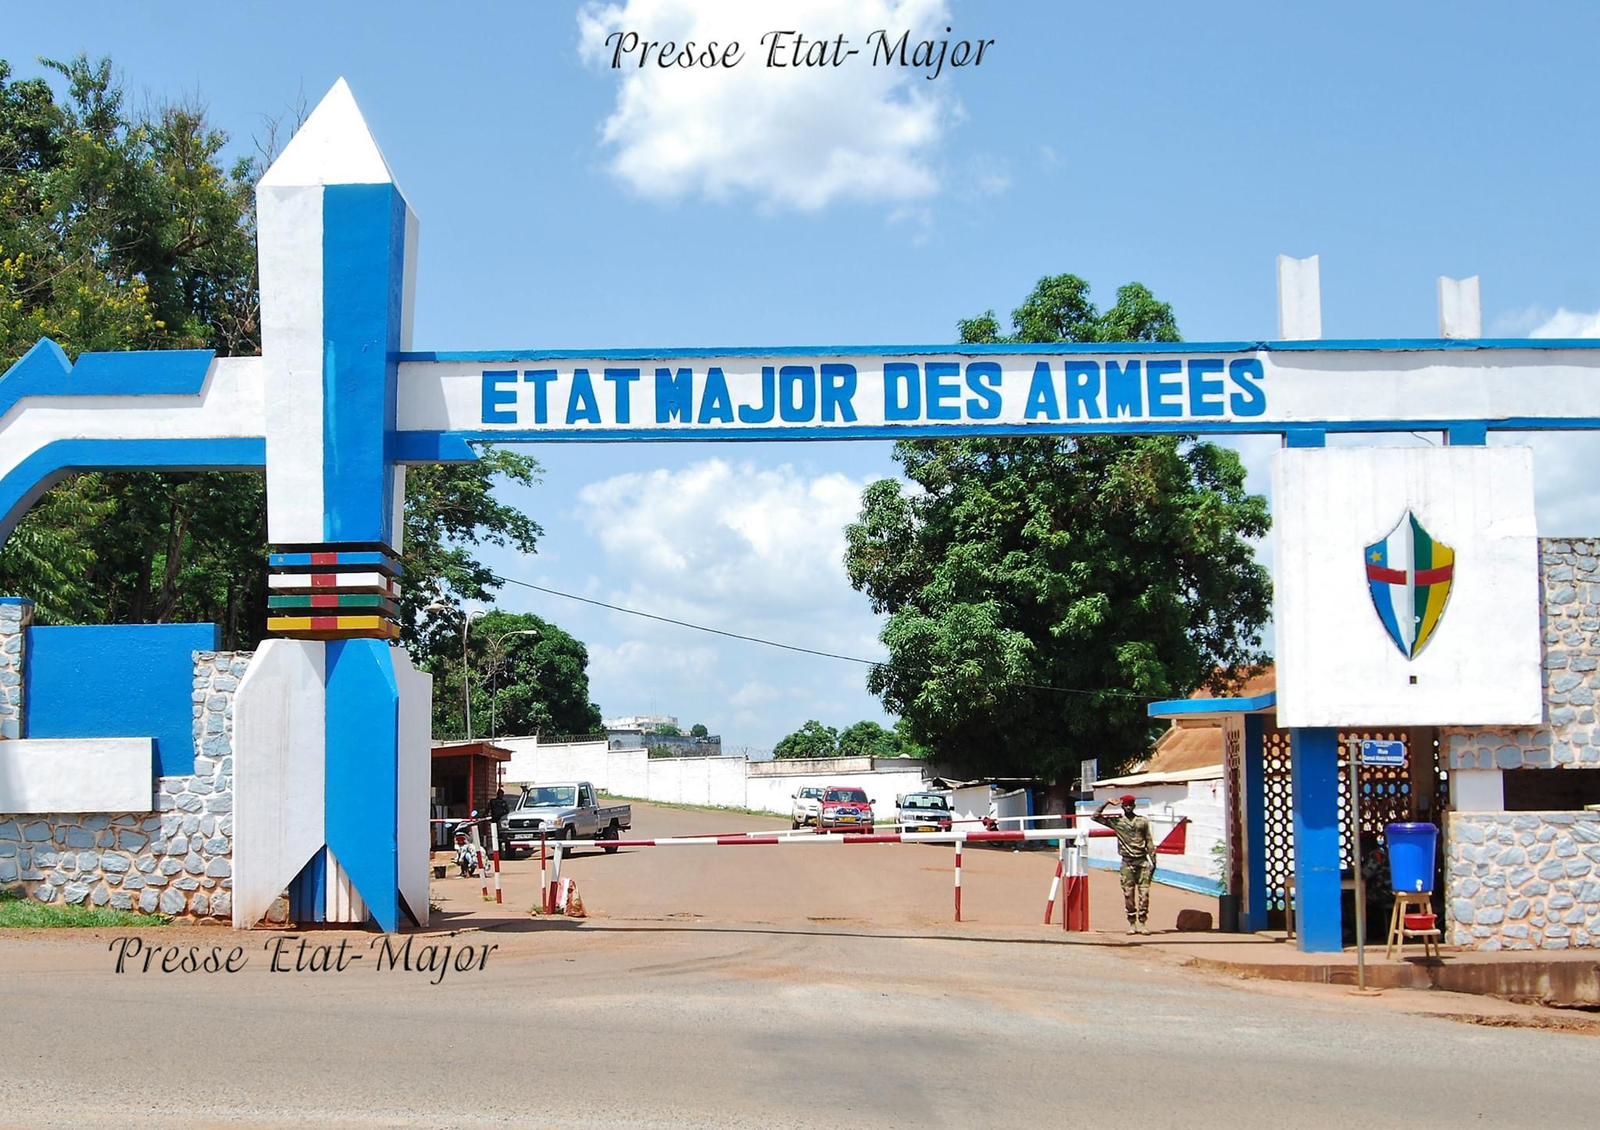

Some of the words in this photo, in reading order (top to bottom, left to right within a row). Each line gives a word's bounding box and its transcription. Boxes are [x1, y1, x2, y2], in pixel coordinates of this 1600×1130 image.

[481, 367, 641, 425] ETAT
[654, 363, 858, 425] MAJOR
[883, 361, 1003, 421] DES
[1023, 358, 1267, 421] ARMEES
